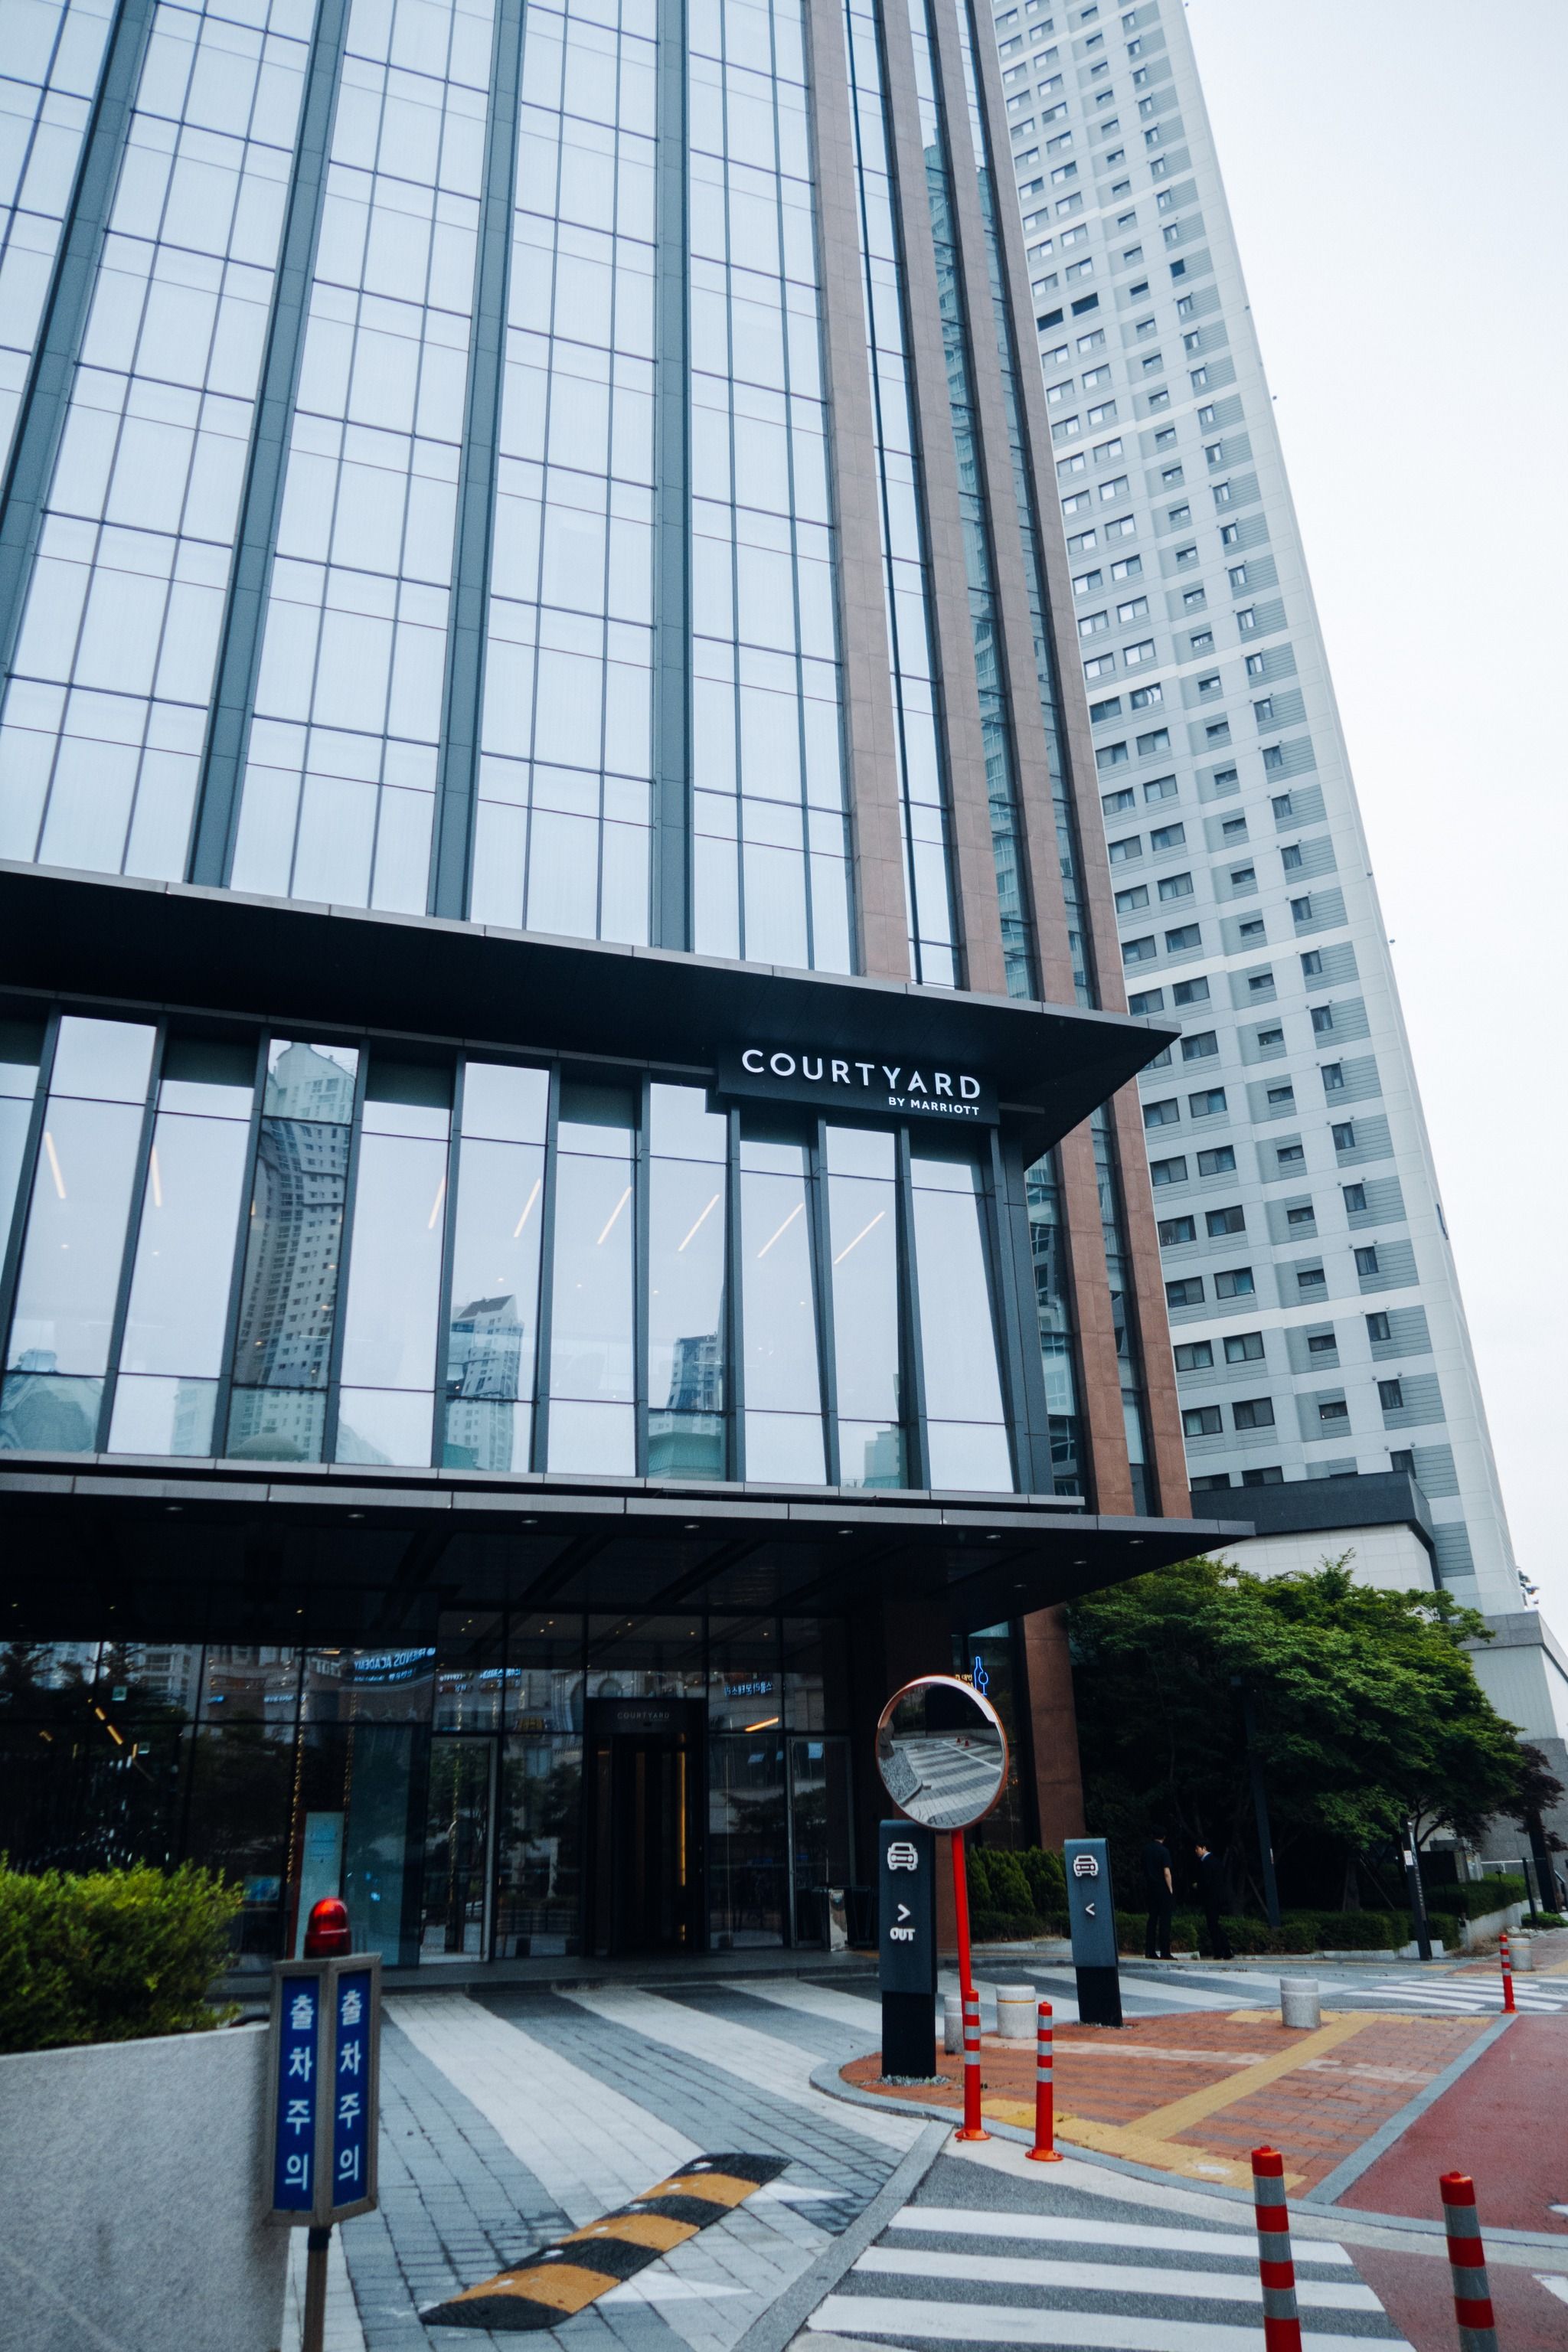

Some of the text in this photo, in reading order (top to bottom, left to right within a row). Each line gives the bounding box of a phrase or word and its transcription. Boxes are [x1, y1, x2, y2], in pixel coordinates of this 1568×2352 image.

[742, 1049, 981, 1099] COURTYARD
[888, 1096, 980, 1116] BY MARRIOTT
[617, 1710, 670, 1720] COURTYARD
[890, 1927, 916, 1942] OUT
[285, 1994, 314, 2190] 출차주의
[338, 1989, 362, 2181] 출차주의
